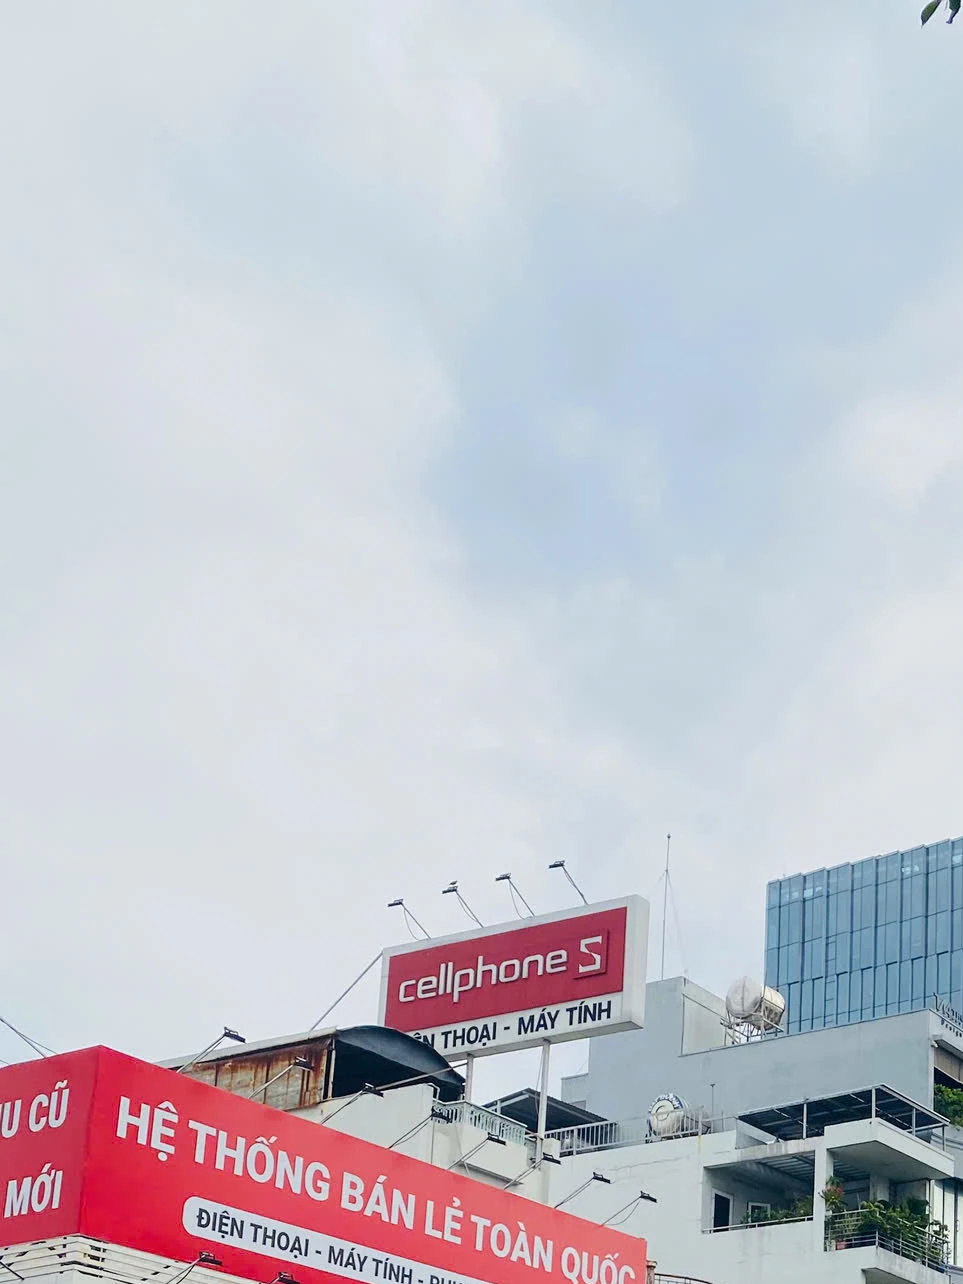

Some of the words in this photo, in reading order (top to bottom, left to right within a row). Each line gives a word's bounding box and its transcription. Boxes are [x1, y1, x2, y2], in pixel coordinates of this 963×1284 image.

[399, 949, 567, 1003] cellphone
[441, 1022, 497, 1047] THOẠI
[518, 1008, 559, 1035] MÁY
[566, 1001, 612, 1026] TÍNH
[28, 1080, 70, 1133] CŨ
[4, 1163, 64, 1218] MỚI
[116, 1095, 180, 1162] HỆ
[188, 1119, 331, 1202] THỐNG
[340, 1172, 416, 1231] BÁN
[424, 1196, 464, 1245] LẺ
[470, 1215, 554, 1273] TOÀN
[196, 1208, 245, 1239] ĐIỆN
[250, 1222, 310, 1259] THOẠI
[328, 1245, 370, 1273] MÁY
